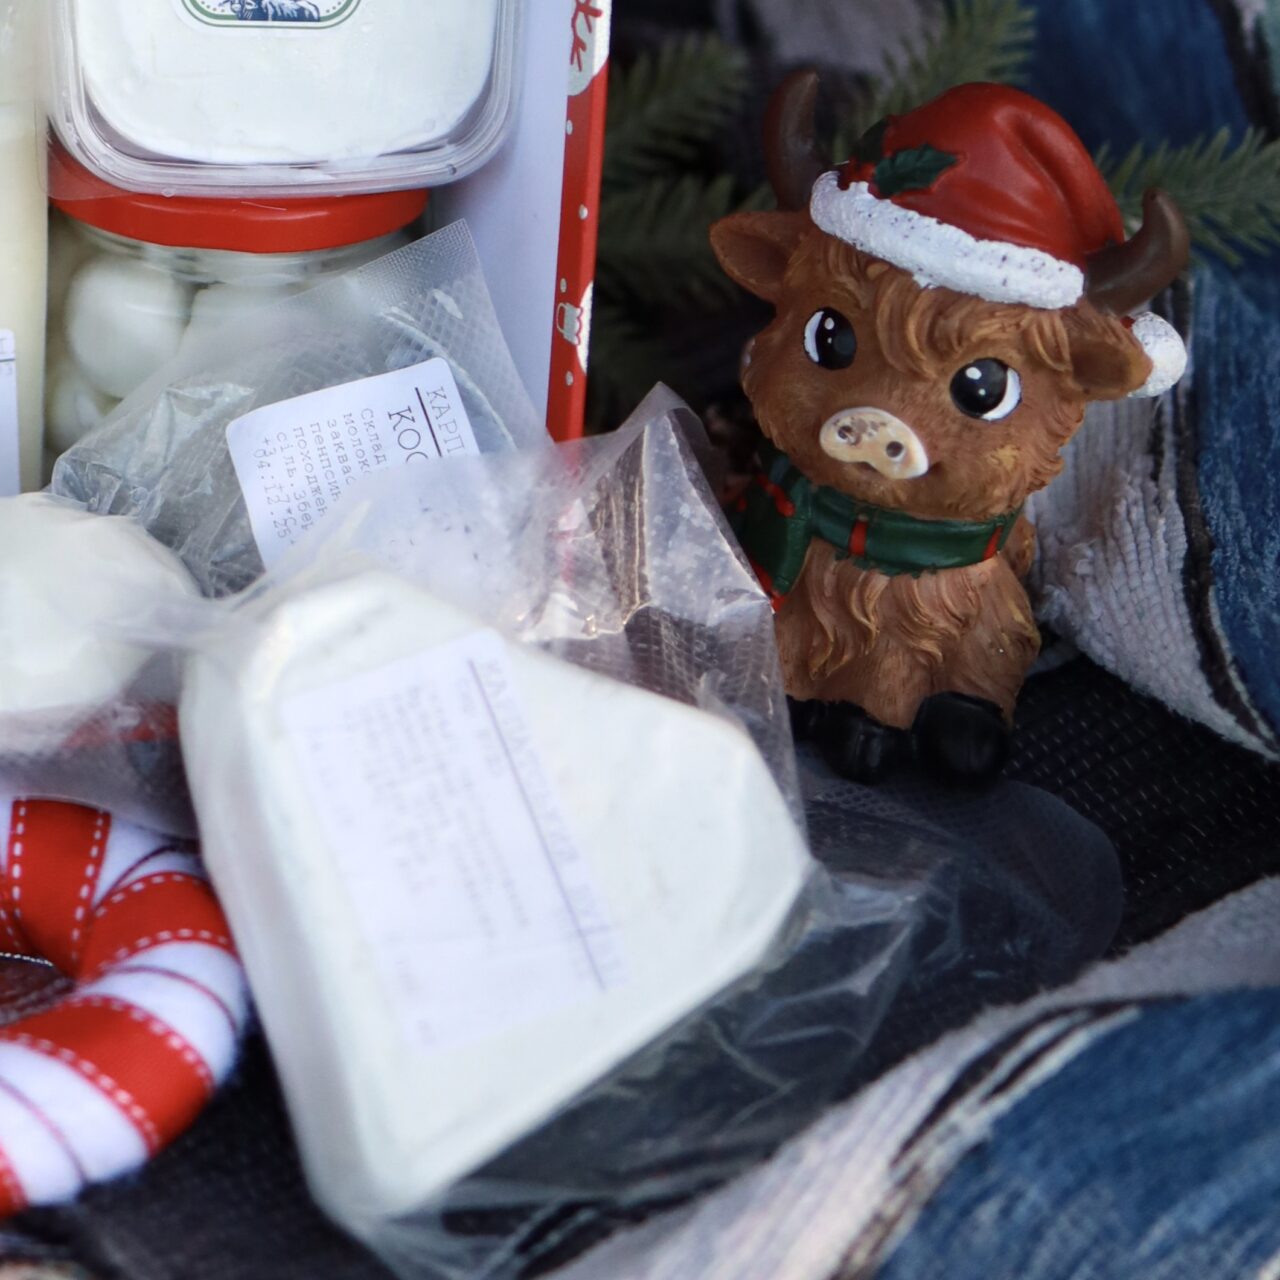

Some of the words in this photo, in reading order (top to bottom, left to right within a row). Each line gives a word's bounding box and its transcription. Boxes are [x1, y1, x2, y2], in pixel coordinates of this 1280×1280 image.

[327, 418, 357, 485] заквас
[426, 386, 465, 454] КАРП
[293, 426, 328, 518] походжен
